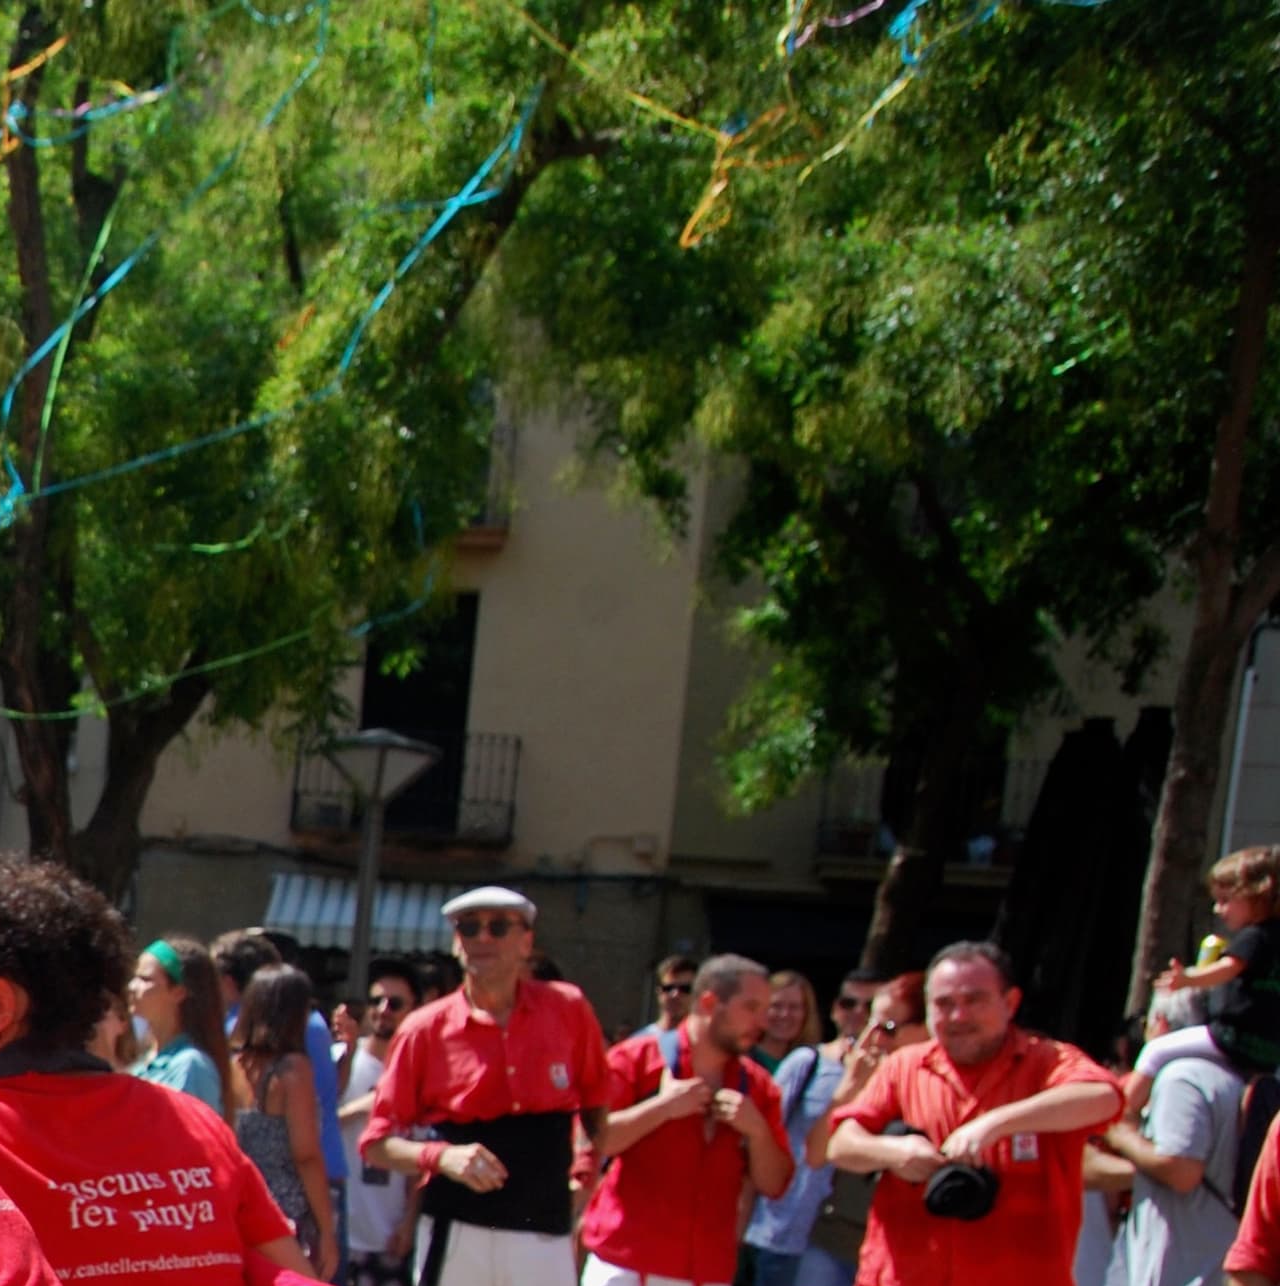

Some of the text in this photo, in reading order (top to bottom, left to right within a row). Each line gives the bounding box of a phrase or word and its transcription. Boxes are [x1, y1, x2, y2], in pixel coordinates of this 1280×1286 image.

[48, 1166, 214, 1201] ascuts per
[69, 1198, 216, 1233] fer pinya
